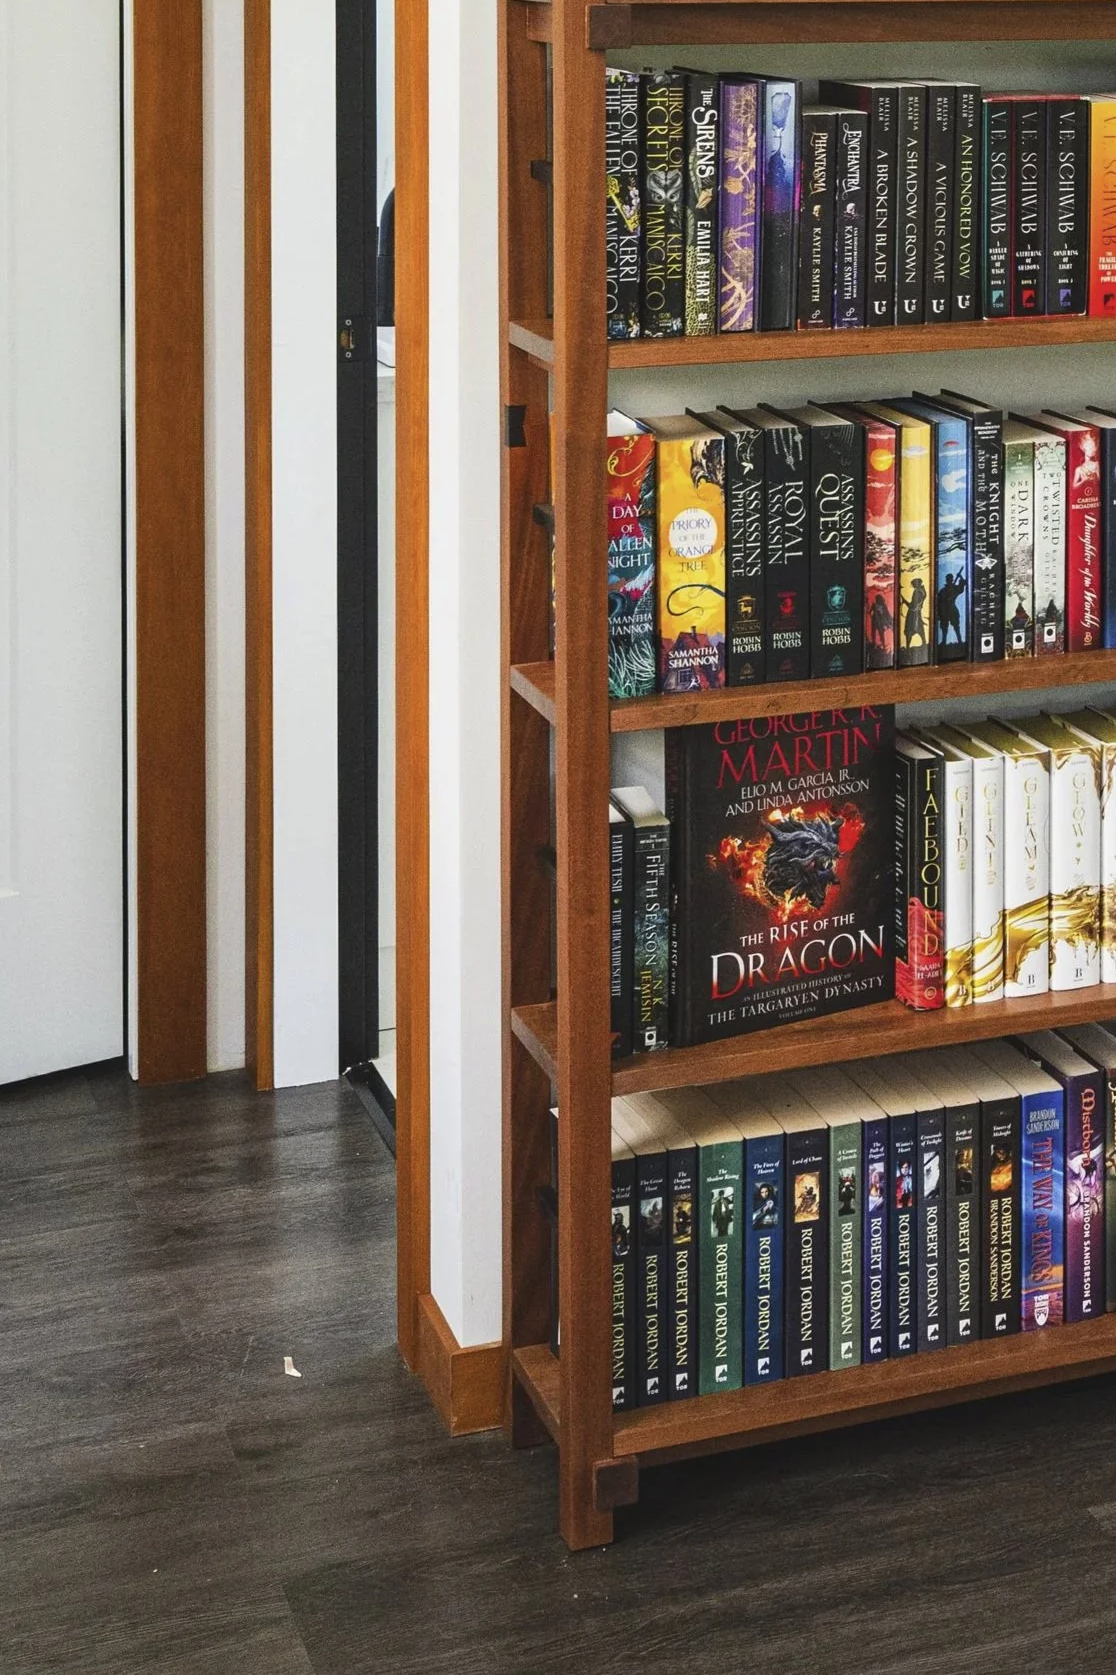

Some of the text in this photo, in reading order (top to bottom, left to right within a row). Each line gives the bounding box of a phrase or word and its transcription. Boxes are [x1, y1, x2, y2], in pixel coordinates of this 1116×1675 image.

[875, 165, 889, 283] BROKEN BLADE
[906, 152, 918, 283] SHADOW CROWN
[959, 161, 973, 277] HONORED VOW
[696, 221, 711, 304] EMILIA HART
[612, 504, 642, 520] DAY
[769, 480, 804, 564] ROYAL ASSASSIN
[815, 473, 840, 561] QUEST
[669, 647, 718, 659] SAMANTHA
[669, 656, 718, 668] SHANNON
[822, 636, 851, 644] HOBB
[823, 628, 850, 637] ROBIN
[717, 723, 881, 789] MARTIN
[741, 786, 766, 799] ELIO
[757, 779, 869, 811] LINDA ANTONSSON
[921, 768, 940, 956] FAEBOUND
[645, 855, 660, 966] FIFTH SEASON
[740, 913, 855, 946] THE RISE OF THE
[710, 926, 884, 1000] DRAGON
[740, 976, 884, 1018] TARGARYEN DYNASTY
[676, 1250, 688, 1365] ROBERT JORDAN
[716, 1244, 728, 1358] ROBERT JORDAN
